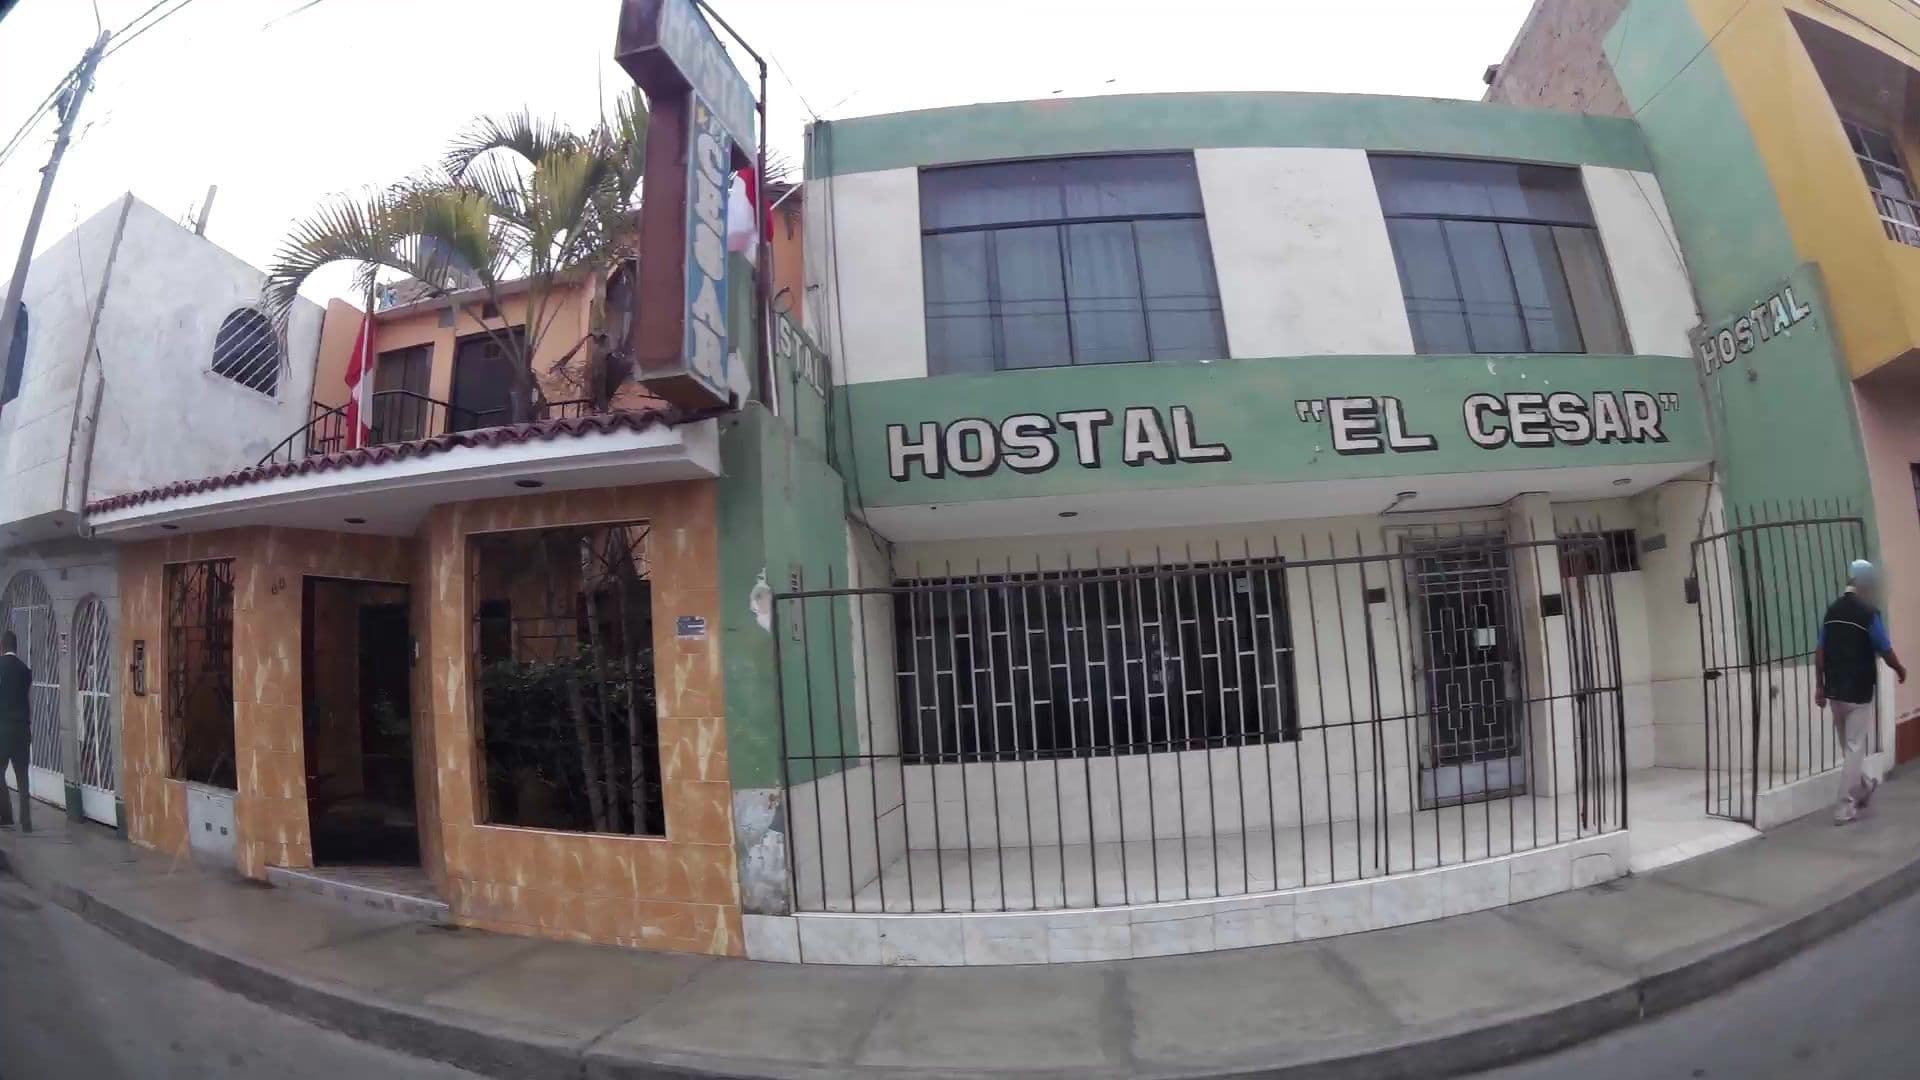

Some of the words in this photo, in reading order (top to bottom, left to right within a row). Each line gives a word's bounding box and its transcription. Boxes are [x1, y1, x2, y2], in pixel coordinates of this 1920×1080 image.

[776, 316, 824, 399] STAL
[1700, 285, 1811, 376] HOSTAL
[886, 405, 1232, 482] HOSTAL
[1295, 396, 1438, 456] "EL
[1463, 391, 1680, 450] CESAR"
